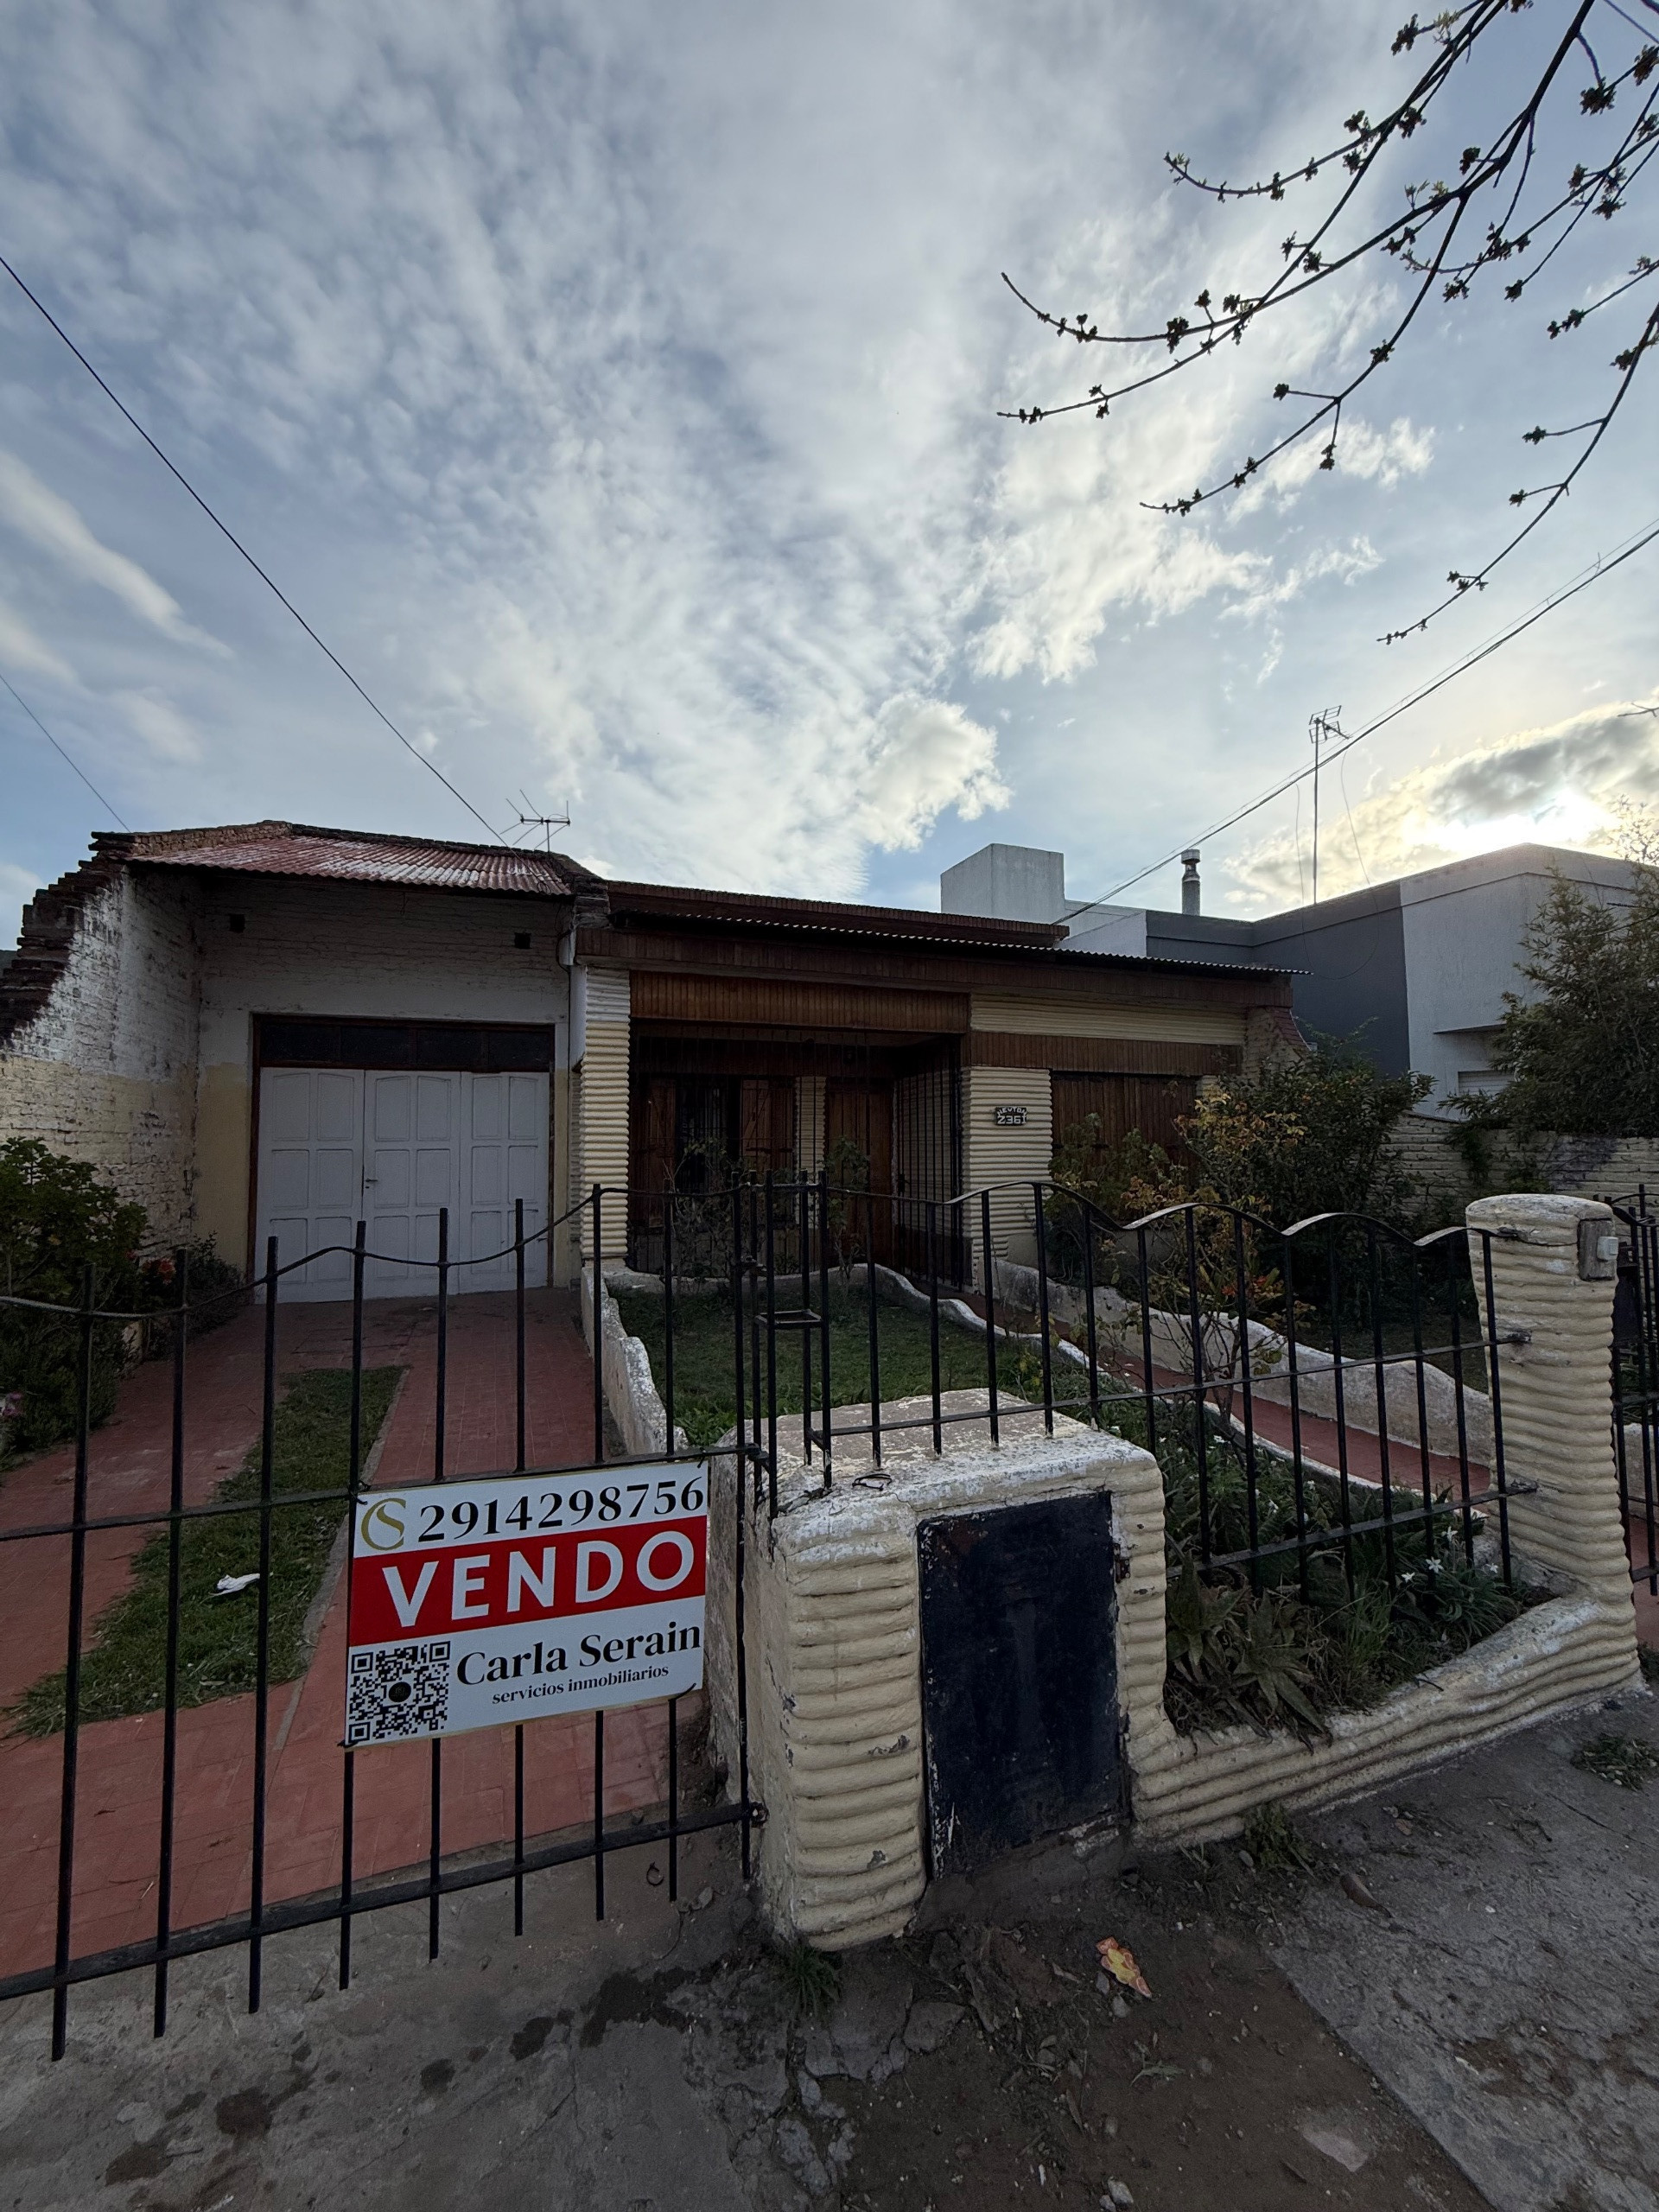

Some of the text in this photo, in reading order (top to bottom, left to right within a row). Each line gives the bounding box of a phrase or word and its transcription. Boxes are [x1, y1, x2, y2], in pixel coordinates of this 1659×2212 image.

[997, 1116, 1027, 1124] 2361
[417, 1476, 704, 1544] 2914298756
[382, 1530, 694, 1628] VENDO
[456, 1621, 701, 1686] Carla Serain
[492, 1663, 669, 1705] servicios inmobiliarios
